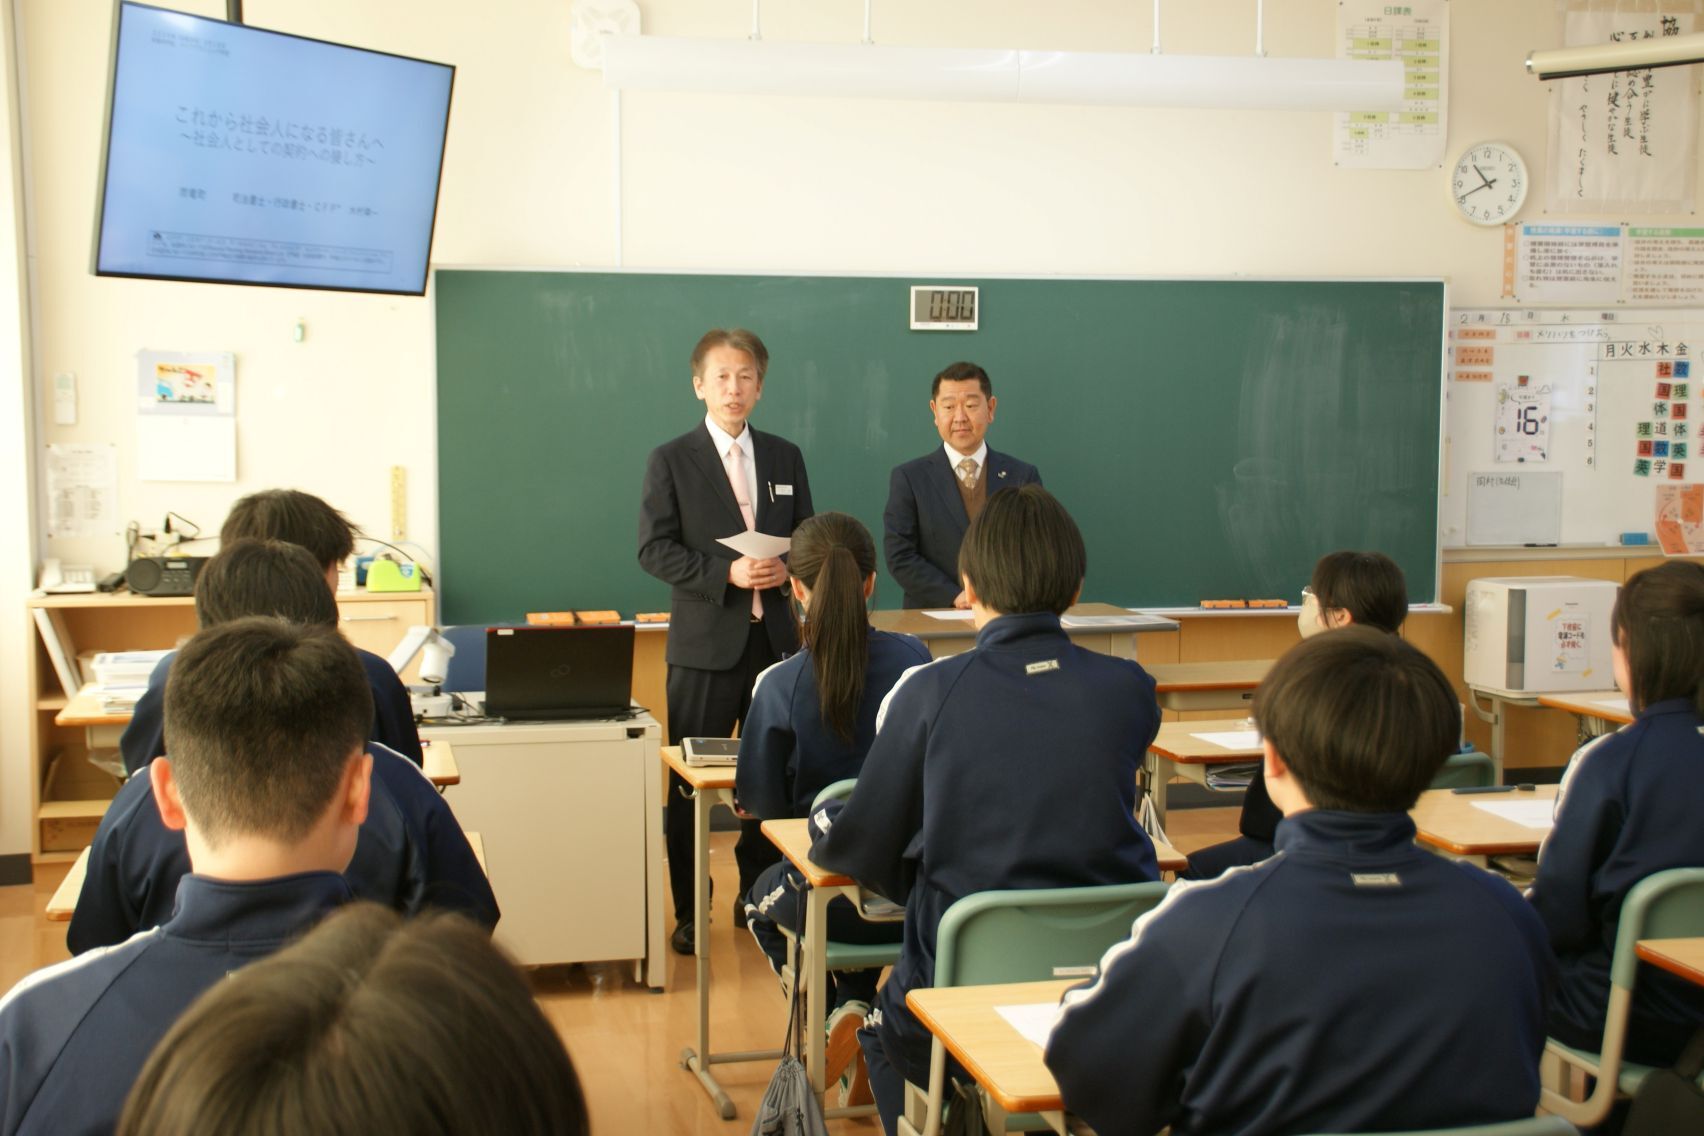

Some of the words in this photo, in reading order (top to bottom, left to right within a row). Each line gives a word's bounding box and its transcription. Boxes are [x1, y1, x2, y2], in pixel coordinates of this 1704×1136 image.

[1460, 313, 1469, 324] 2
[1606, 344, 1615, 357] 月
[1621, 343, 1633, 357] 火
[1639, 341, 1650, 355] 水
[1657, 342, 1670, 355] 木
[1675, 342, 1688, 356] 金
[1657, 362, 1671, 375] 社
[1674, 384, 1687, 398] 理
[1654, 401, 1667, 415] 体
[1517, 406, 1539, 435] 16
[1638, 422, 1650, 436] 理
[1655, 421, 1667, 435] 道
[1674, 423, 1688, 436] 体
[1672, 443, 1686, 456] 英
[1654, 459, 1666, 473] 学
